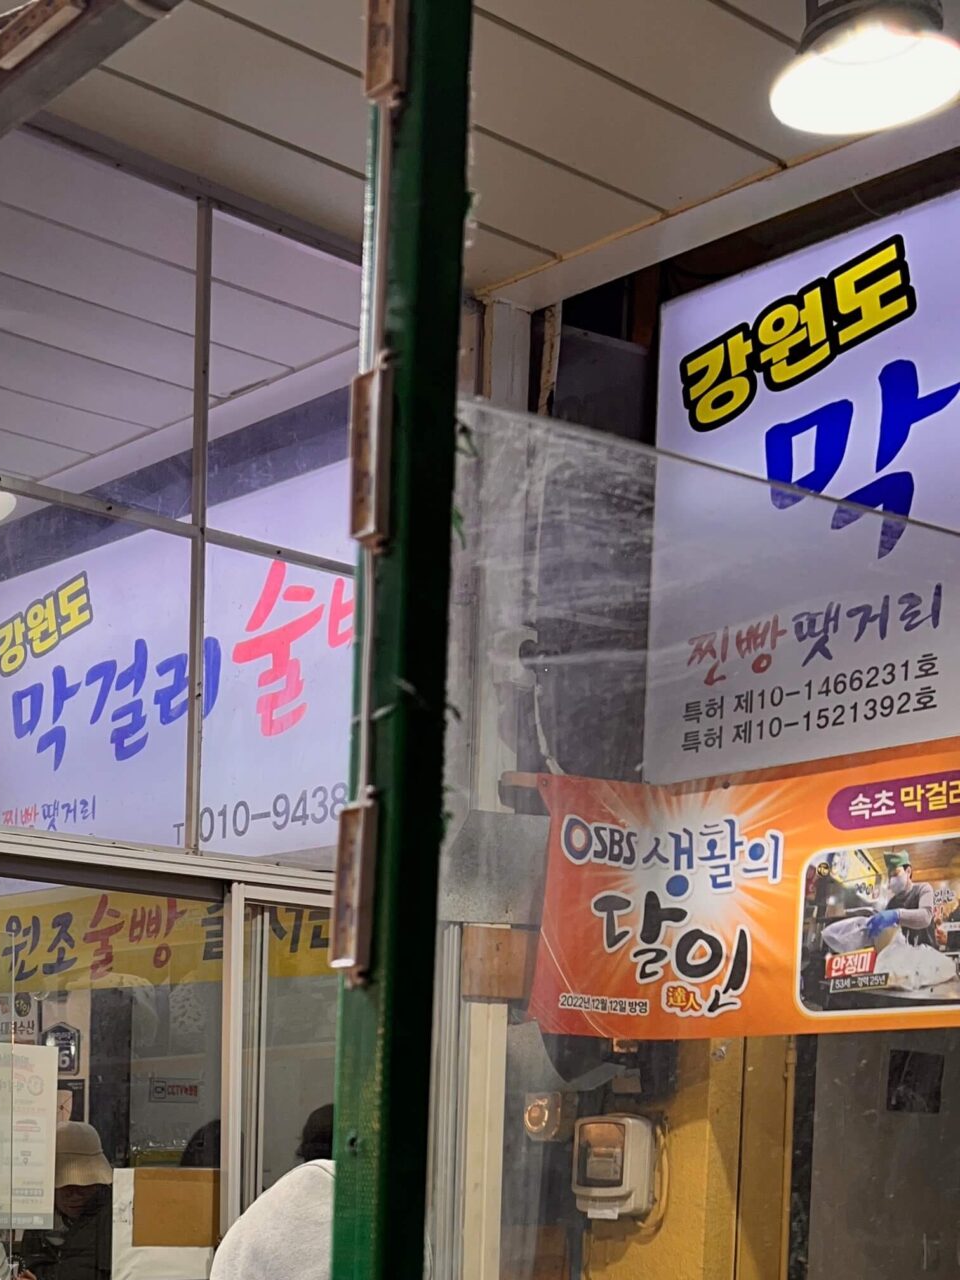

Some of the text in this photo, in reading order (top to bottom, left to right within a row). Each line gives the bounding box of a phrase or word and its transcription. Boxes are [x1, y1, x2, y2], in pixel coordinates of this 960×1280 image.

[680, 234, 917, 433] 강원도
[687, 614, 787, 686] 찐빵
[11, 636, 221, 771] 막걸리
[681, 686, 938, 753] 특허 제10-1521392호
[682, 652, 939, 724] 특허 제10-1466231호
[849, 790, 896, 819] 속초
[593, 818, 783, 898] SBS 생활의
[592, 891, 752, 1013] 달인
[832, 952, 871, 977] 안정미
[560, 993, 648, 1014] 2022년 12월 12일 방영
